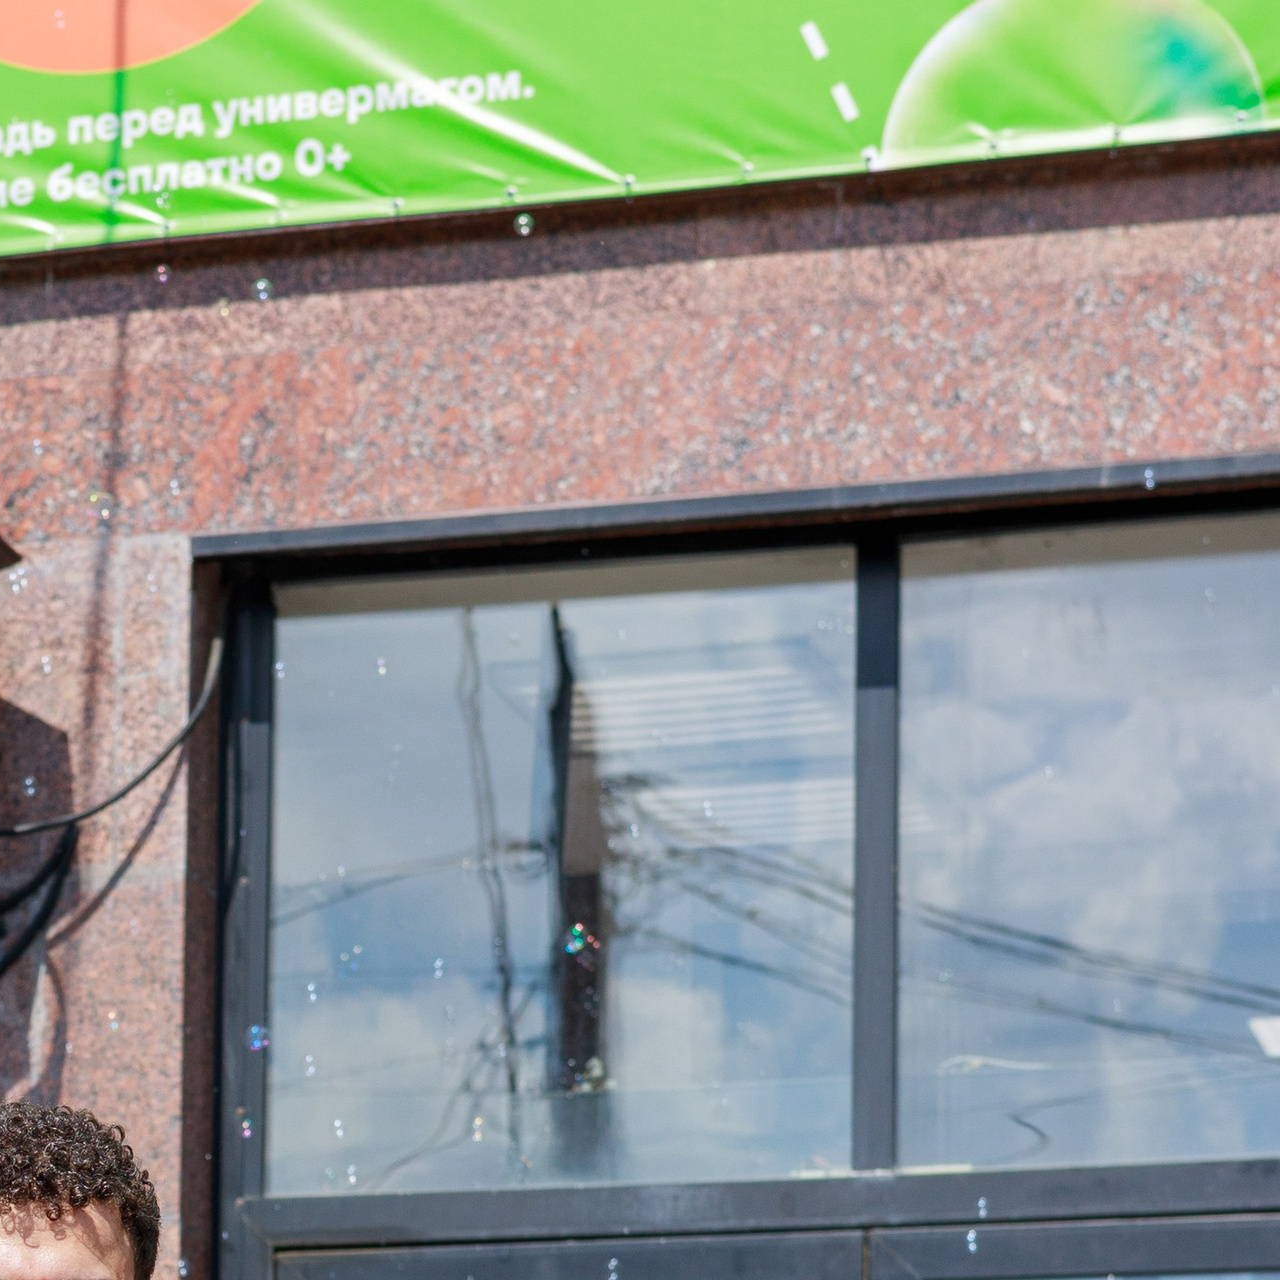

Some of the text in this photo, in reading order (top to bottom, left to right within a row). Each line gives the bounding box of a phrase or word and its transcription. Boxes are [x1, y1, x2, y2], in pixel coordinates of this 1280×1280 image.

[67, 102, 205, 150] перед
[213, 70, 535, 139] универмагом.
[45, 151, 284, 203] бесплатно
[294, 138, 352, 177] 0+
